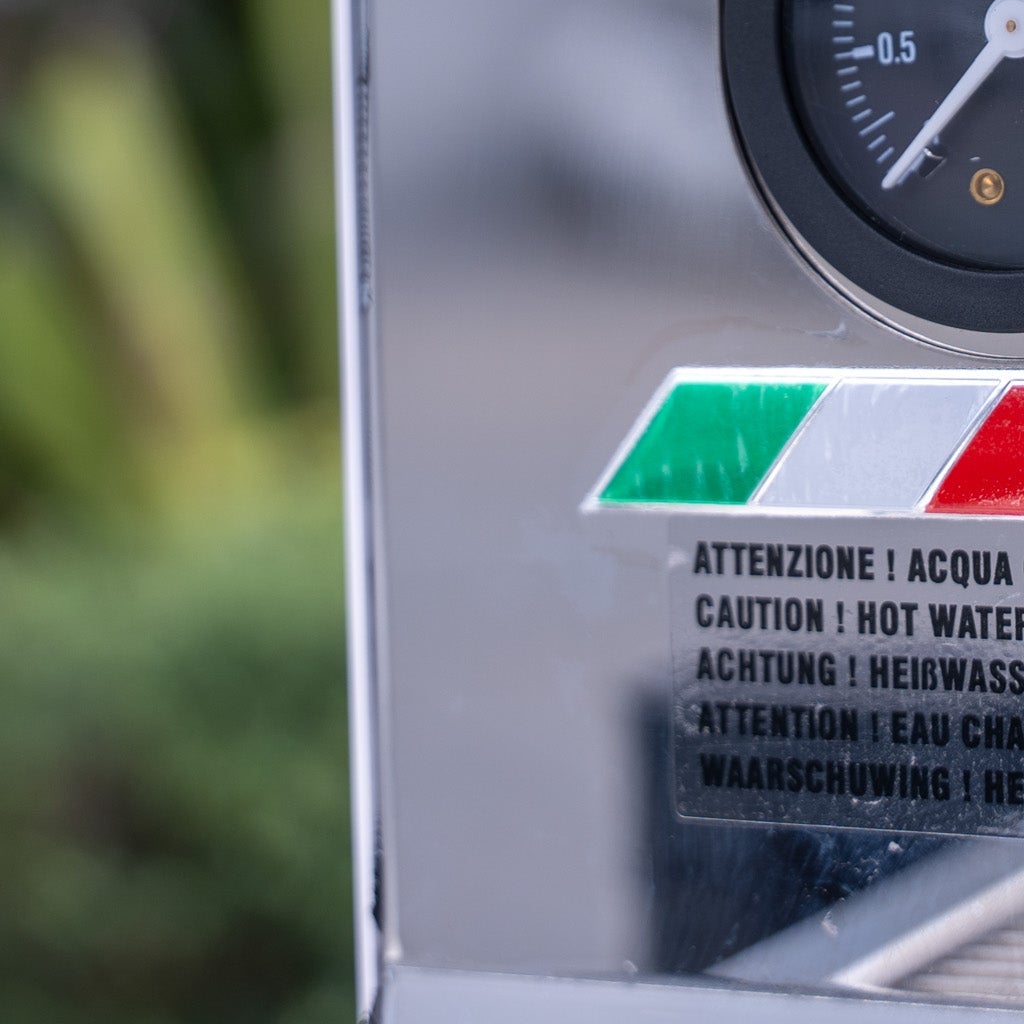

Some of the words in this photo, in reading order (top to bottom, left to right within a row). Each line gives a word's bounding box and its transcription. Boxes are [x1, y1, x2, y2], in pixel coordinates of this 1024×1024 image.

[877, 30, 917, 65] 0.5
[694, 540, 875, 581] ATTENZIONE
[907, 548, 1013, 588] ACQUA
[696, 593, 824, 632] CAUTION
[857, 600, 919, 636] HOT
[697, 646, 837, 686] ACHTUNG
[699, 700, 859, 742] ATTENTION
[891, 711, 951, 747] EAU
[700, 752, 950, 801] WAARSCHUWING
